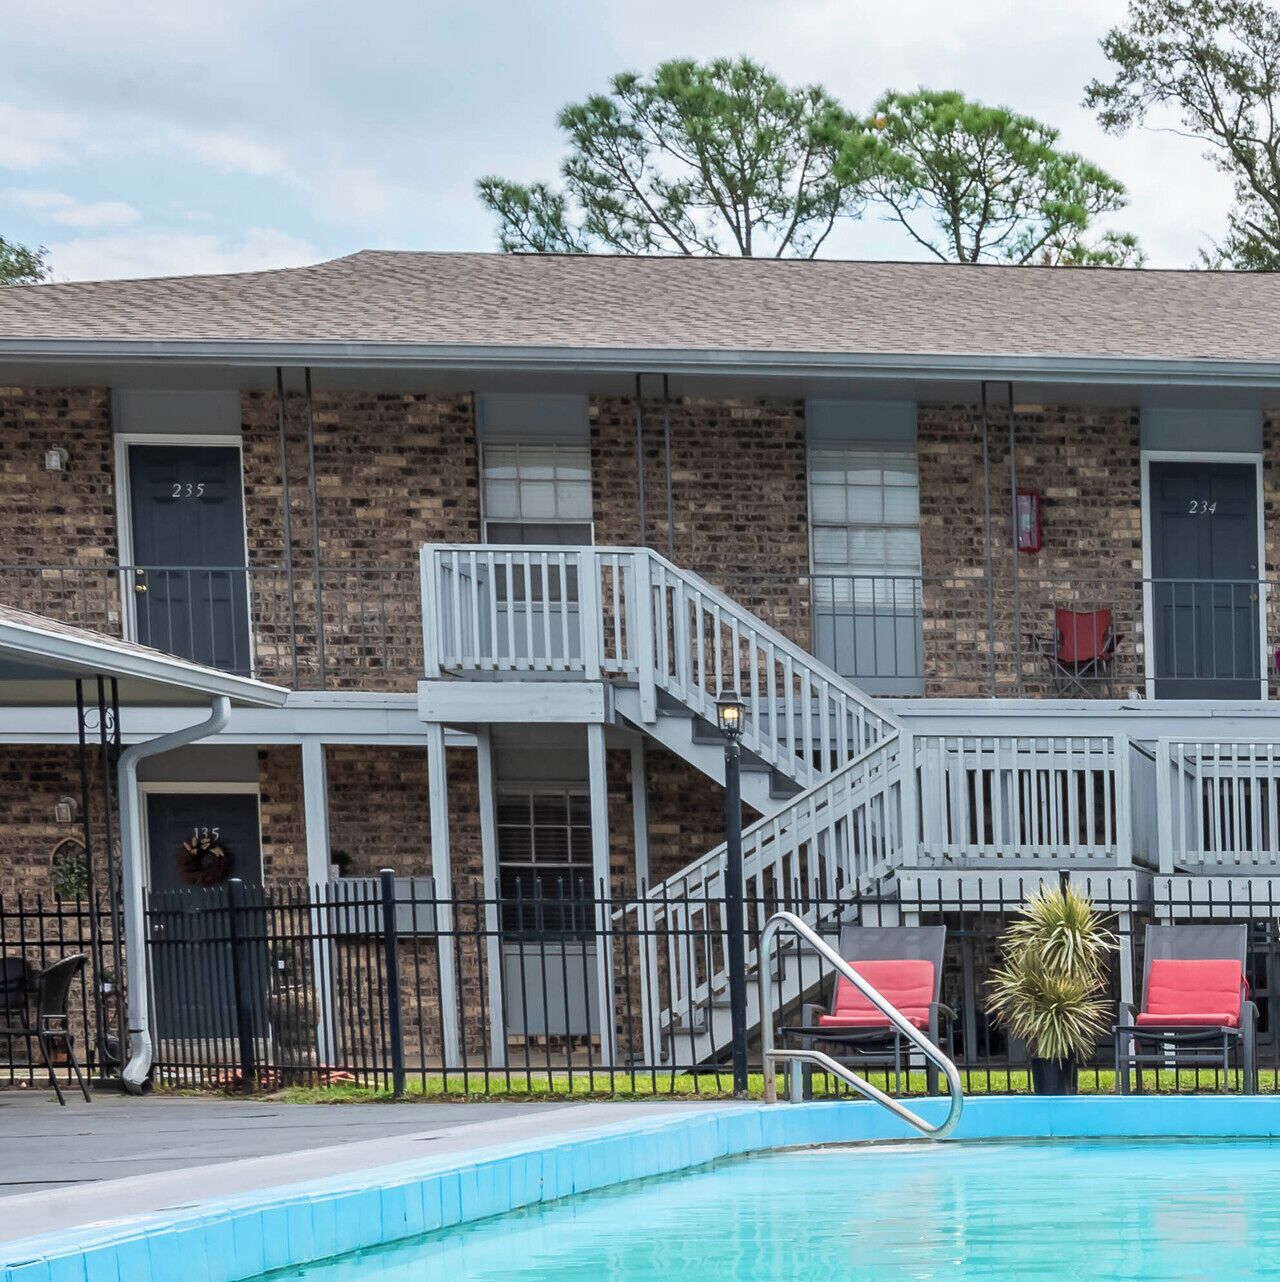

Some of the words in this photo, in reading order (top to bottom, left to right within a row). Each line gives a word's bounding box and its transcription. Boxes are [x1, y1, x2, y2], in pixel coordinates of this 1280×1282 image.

[172, 483, 206, 498] 235
[1188, 500, 1217, 514] 234
[194, 827, 220, 842] 135
